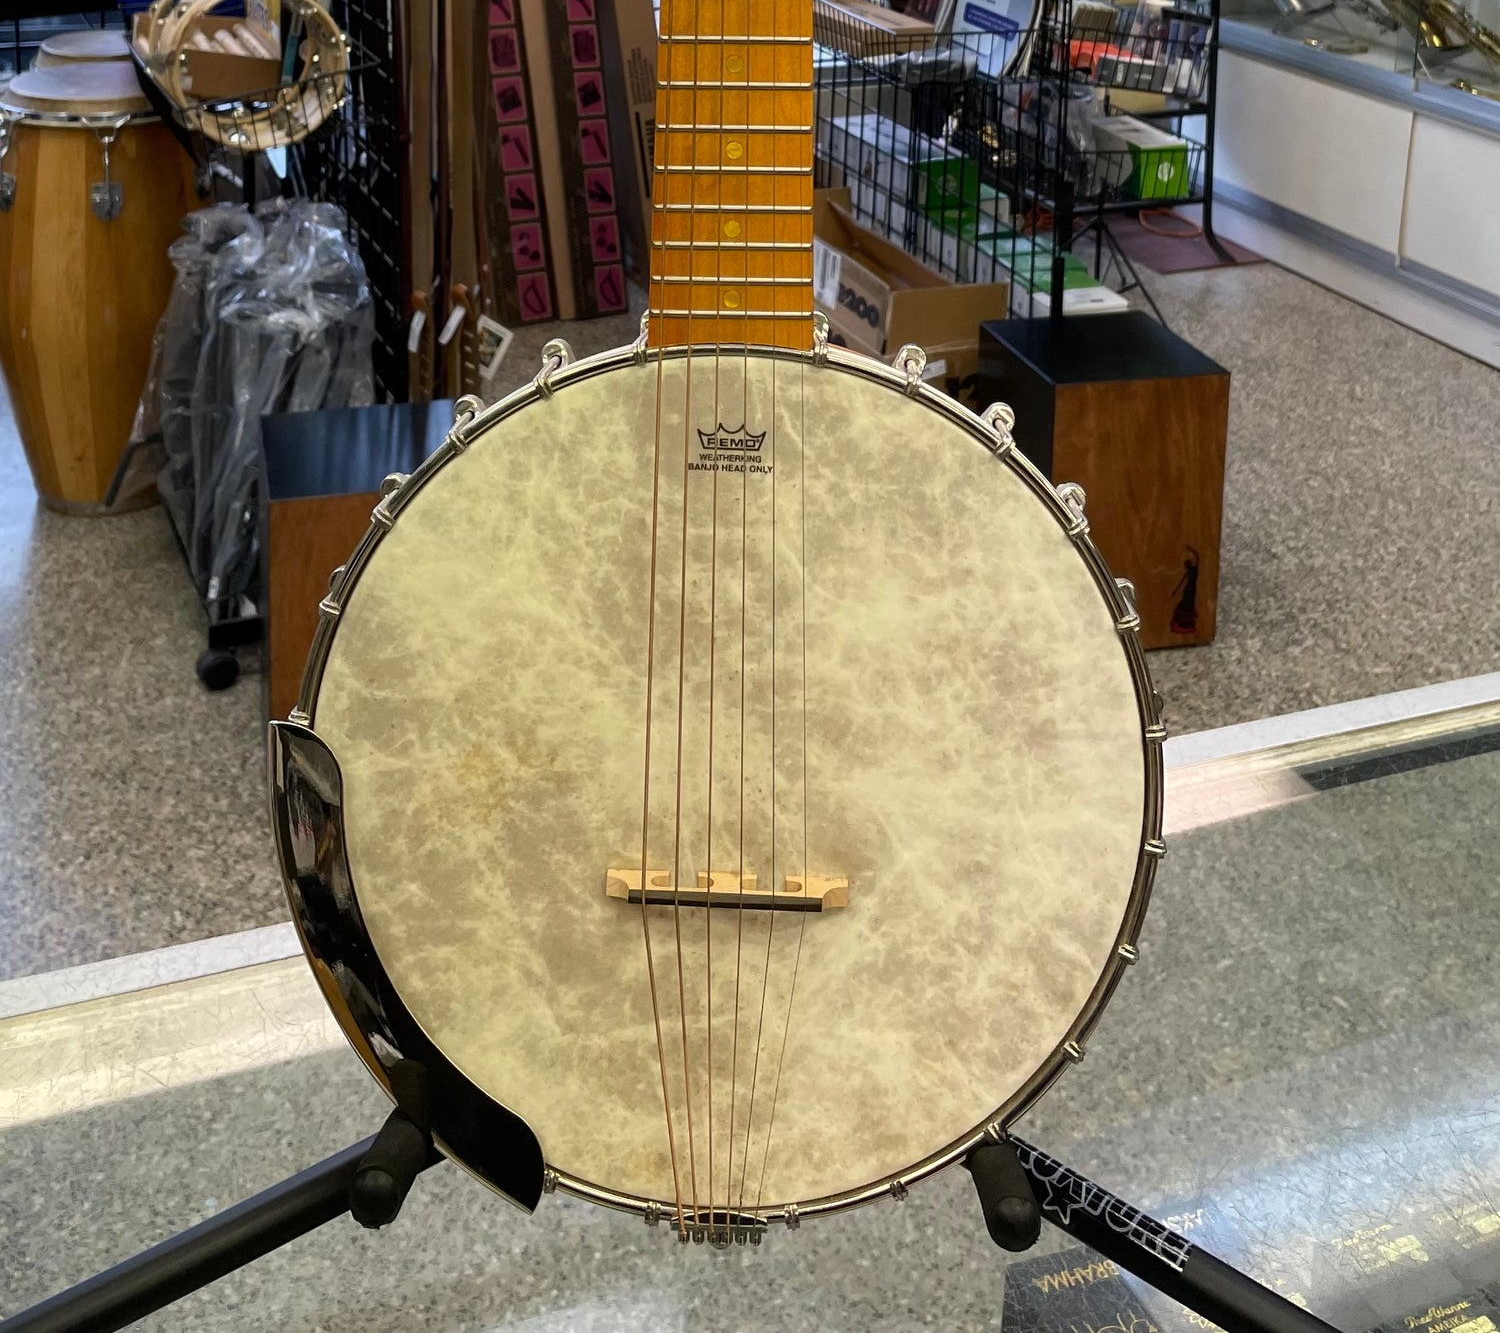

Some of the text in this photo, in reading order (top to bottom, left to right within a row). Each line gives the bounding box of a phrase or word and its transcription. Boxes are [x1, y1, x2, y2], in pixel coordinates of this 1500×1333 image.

[707, 437, 757, 448] REMO
[699, 453, 762, 464] WEATHERKING
[688, 463, 774, 475] BANJO HEAD ONLY
[1033, 1259, 1120, 1294] BRAHMA
[1428, 1299, 1472, 1319] Wanne
